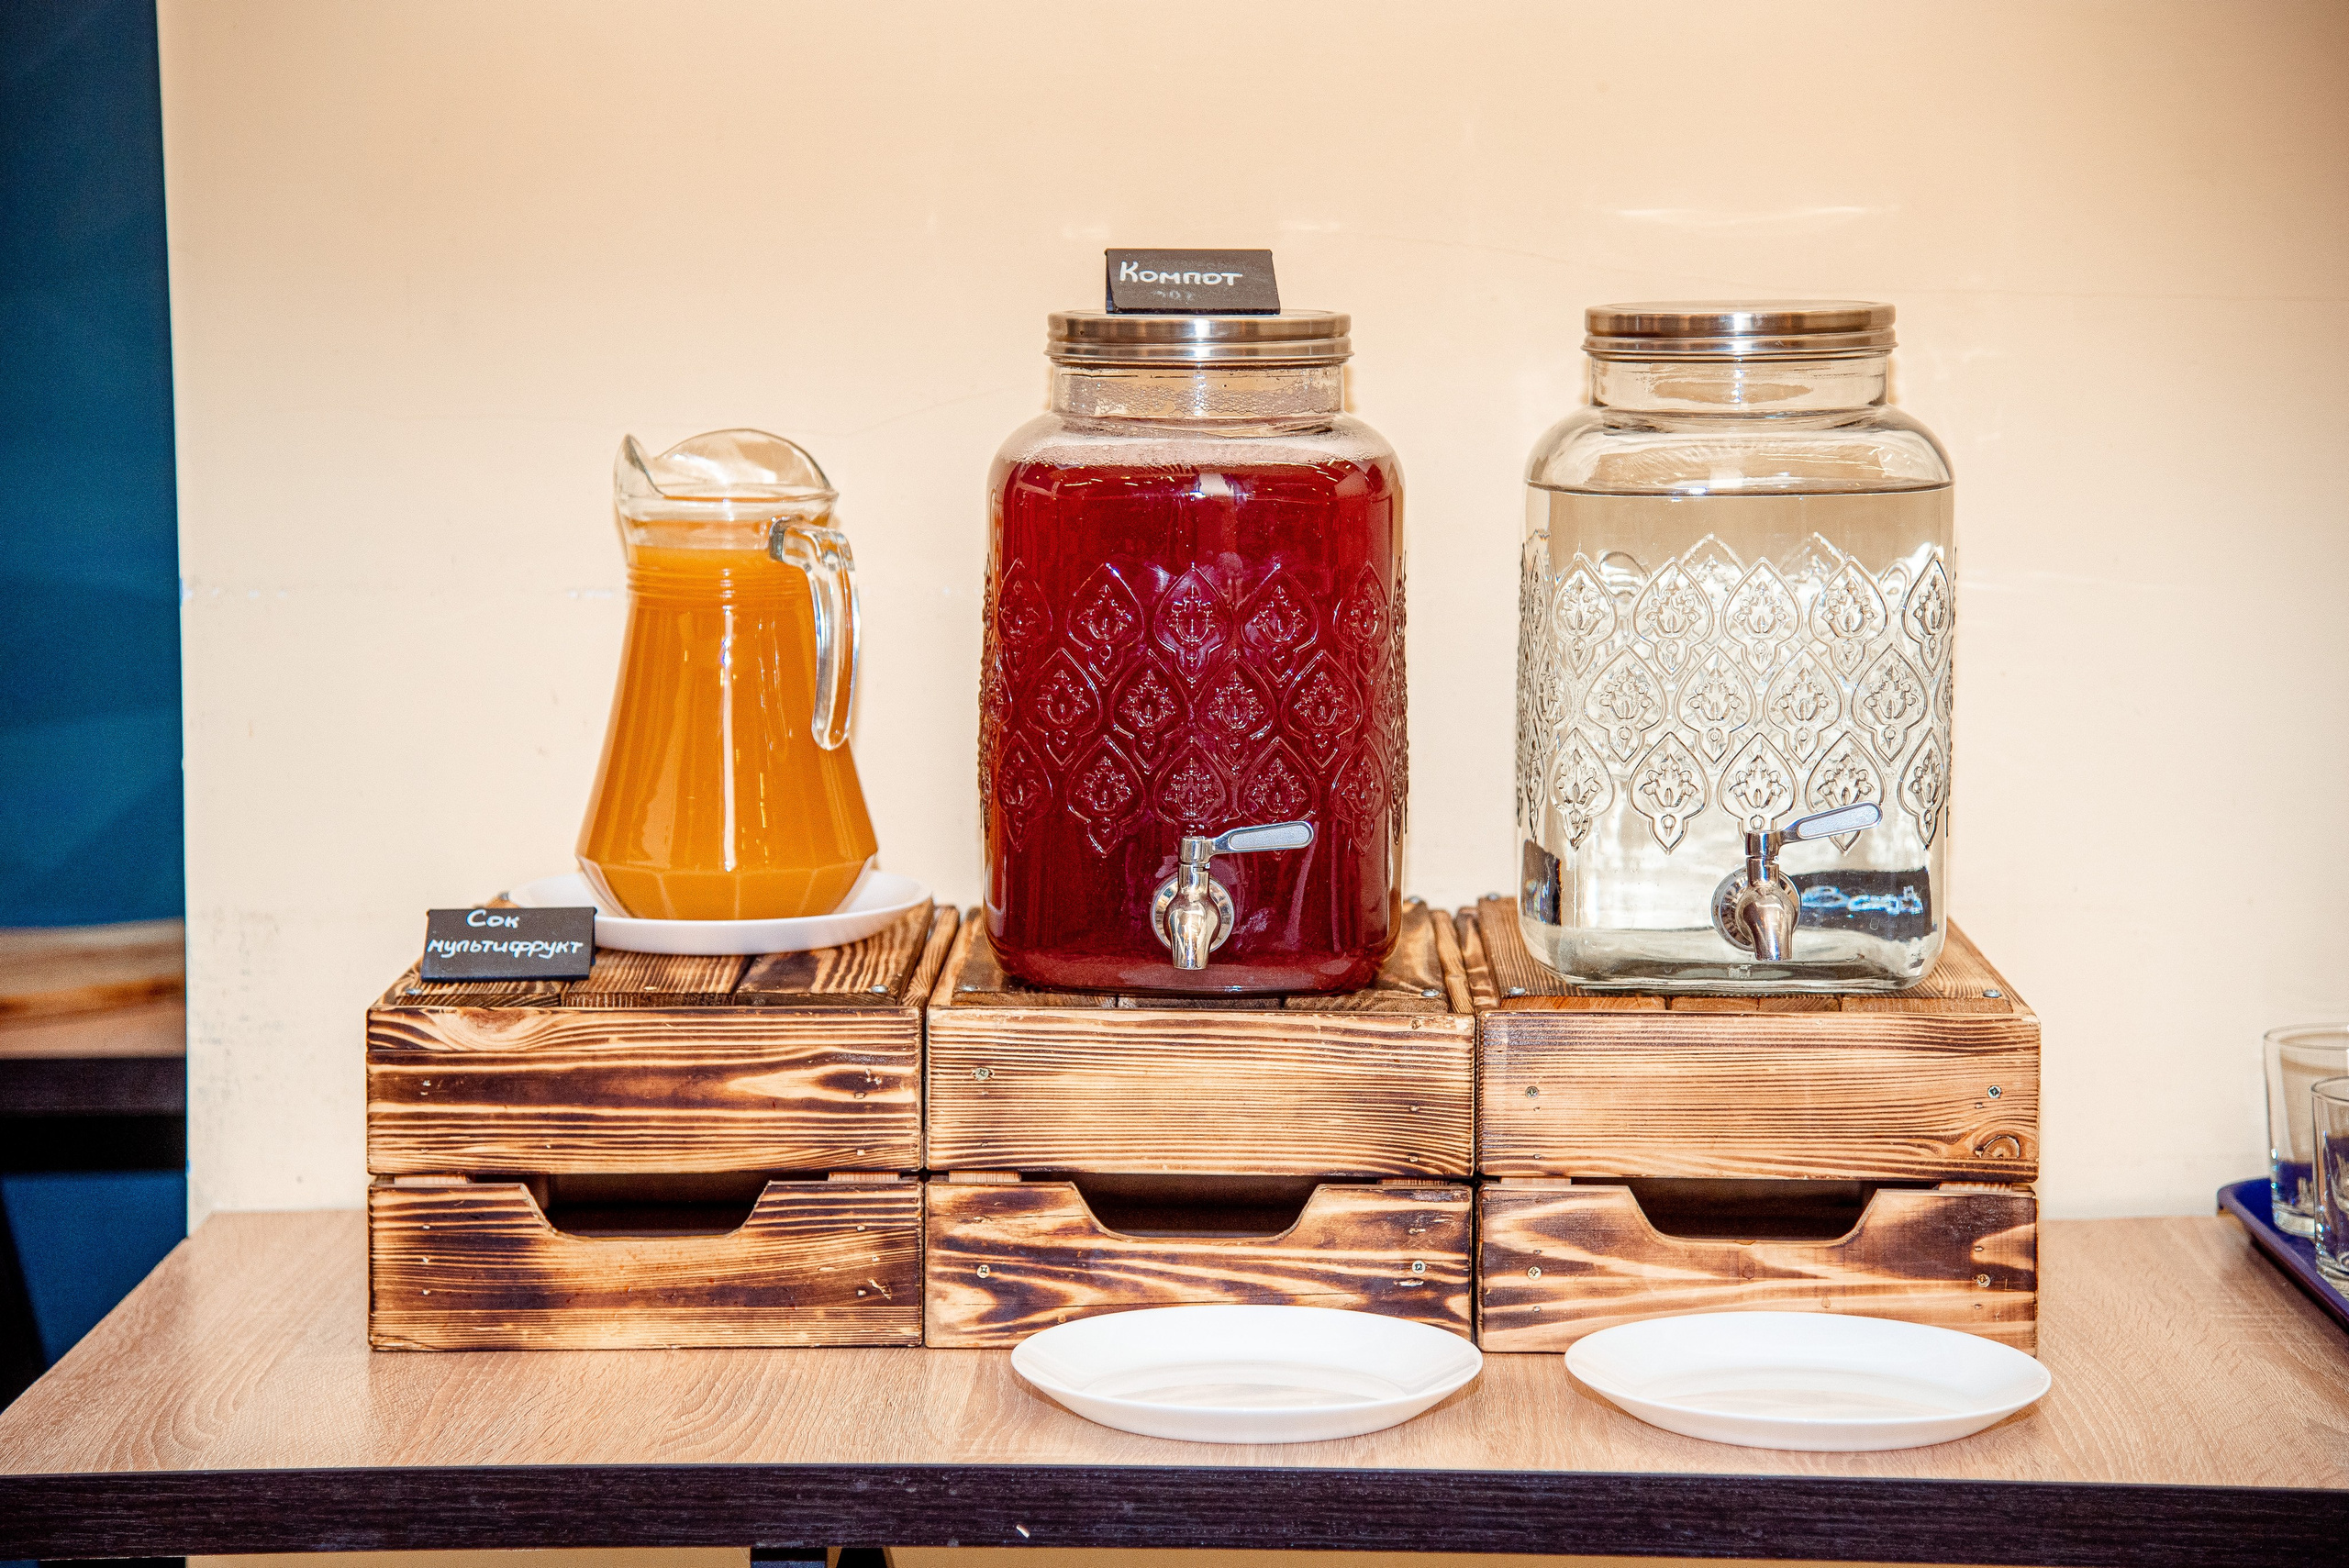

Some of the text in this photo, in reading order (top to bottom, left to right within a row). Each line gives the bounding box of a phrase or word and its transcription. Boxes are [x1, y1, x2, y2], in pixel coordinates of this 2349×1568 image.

[1119, 261, 1243, 286] Компот
[466, 909, 519, 929] Сок
[427, 940, 584, 960] мультифрукт
